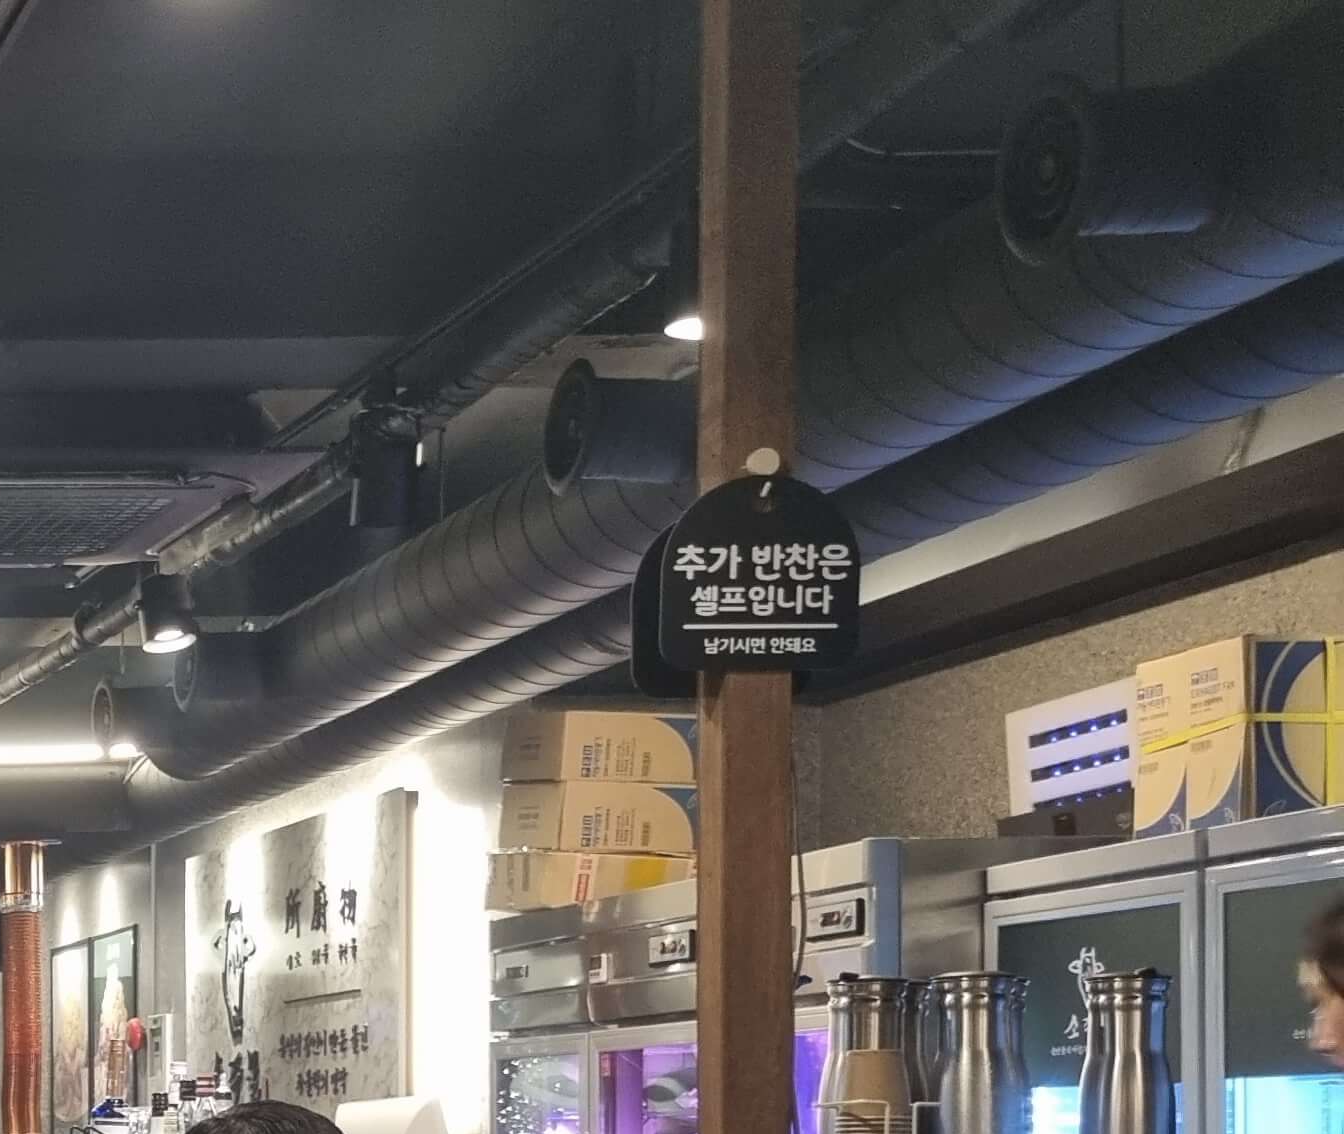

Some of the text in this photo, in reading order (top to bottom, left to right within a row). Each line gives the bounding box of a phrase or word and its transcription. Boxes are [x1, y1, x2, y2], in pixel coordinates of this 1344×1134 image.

[673, 543, 852, 581] 추가 반찬은
[690, 584, 834, 617] 셀프입니다
[704, 637, 817, 655] 남기시면 안돼요
